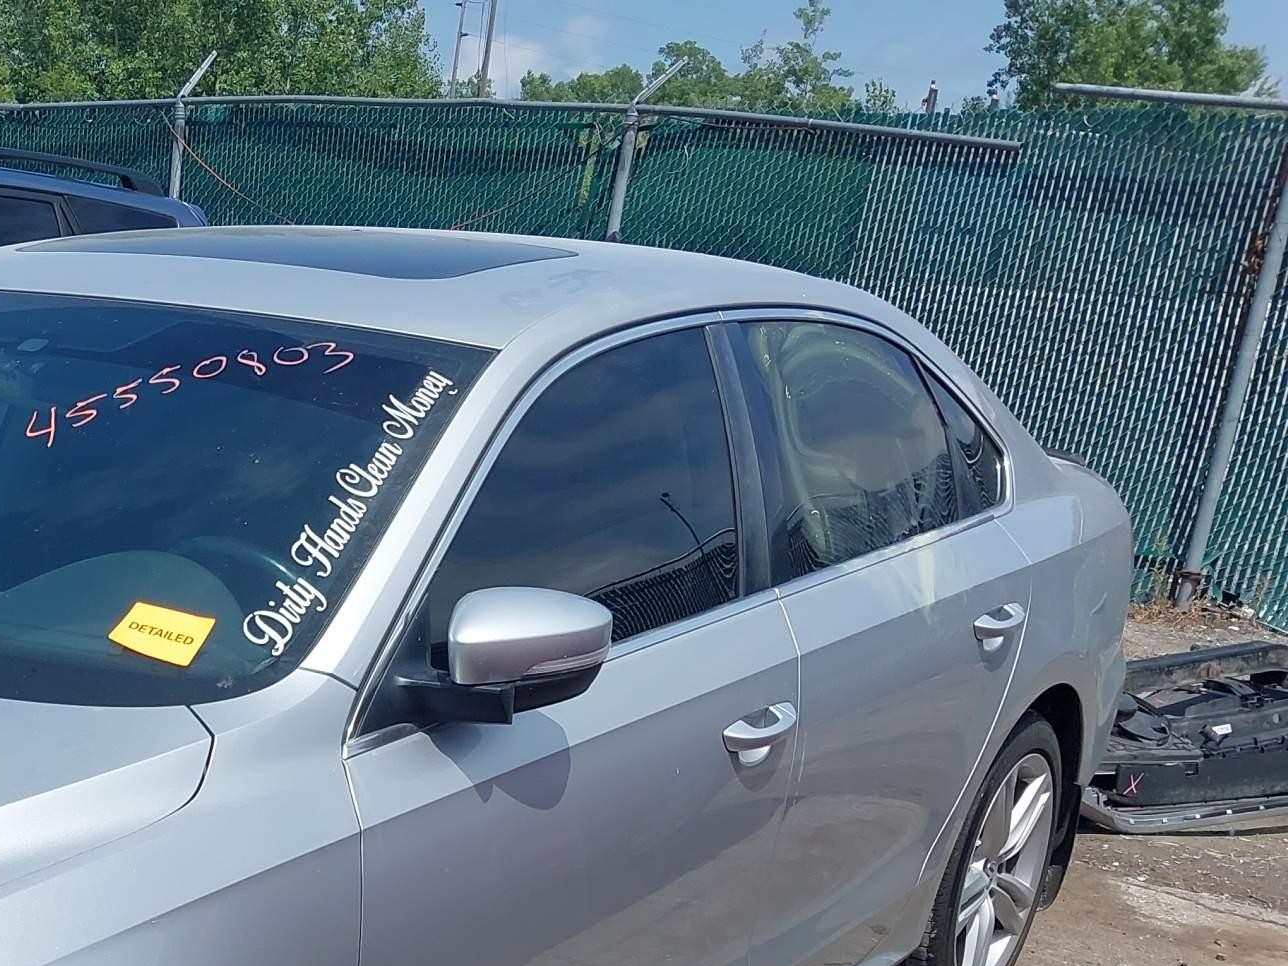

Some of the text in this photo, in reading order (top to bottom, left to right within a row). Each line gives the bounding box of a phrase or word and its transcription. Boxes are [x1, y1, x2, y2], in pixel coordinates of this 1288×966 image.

[25, 342, 355, 448] 45550803
[243, 370, 458, 656] Dirty Hands Clean Money
[128, 621, 195, 645] DETAILED
